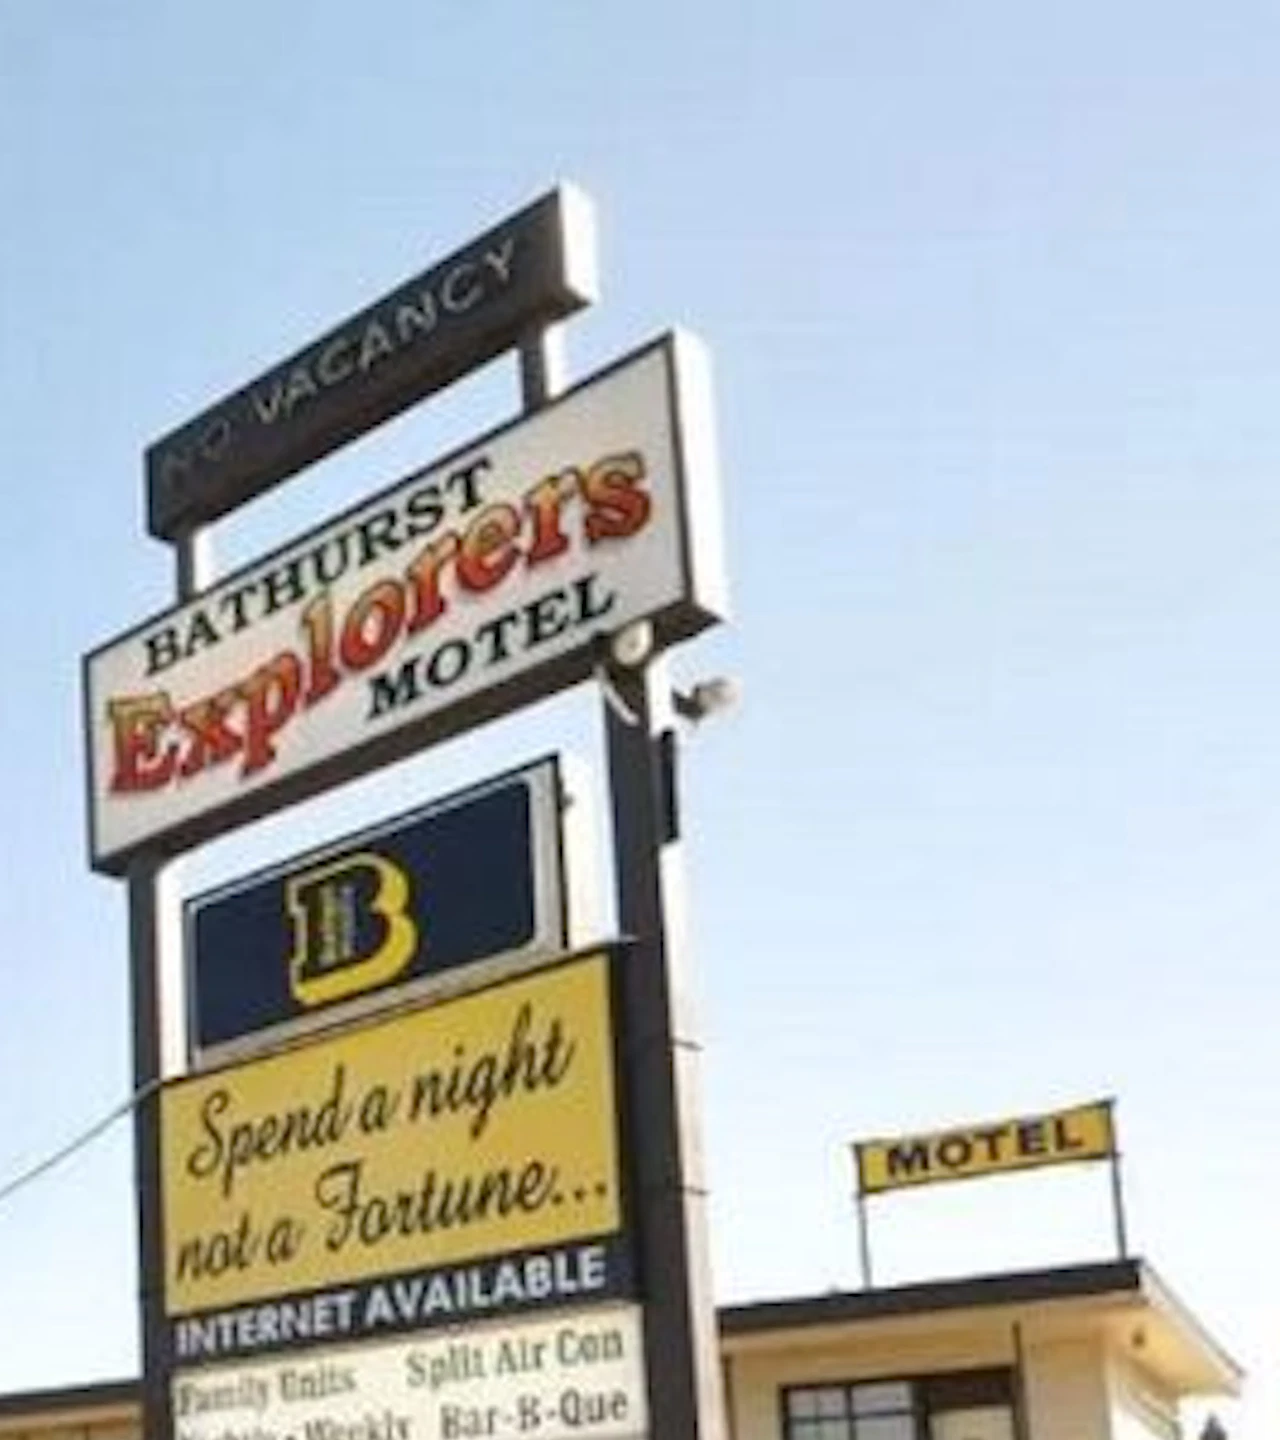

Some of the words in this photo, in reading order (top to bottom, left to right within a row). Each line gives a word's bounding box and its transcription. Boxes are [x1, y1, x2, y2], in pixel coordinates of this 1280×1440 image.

[250, 238, 516, 424] VACANCY
[104, 450, 653, 797] Explorers
[145, 458, 492, 675] BATHURST
[364, 573, 617, 721] MOTEL
[187, 1063, 351, 1198] Spend
[357, 1083, 398, 1136] a
[408, 1002, 577, 1137] night
[886, 1114, 1083, 1178] MOTEL
[175, 1214, 262, 1283] not
[265, 1218, 301, 1264] a
[315, 1160, 608, 1252] Fortune...
[176, 1293, 363, 1357] INTERNET
[364, 1246, 606, 1331] AVAILABLE
[179, 1375, 269, 1417] Family
[279, 1362, 358, 1402] Units
[405, 1343, 486, 1390] Split
[495, 1337, 546, 1376] Air
[556, 1328, 624, 1367] Con
[440, 1388, 629, 1440] Bar-B-Que
